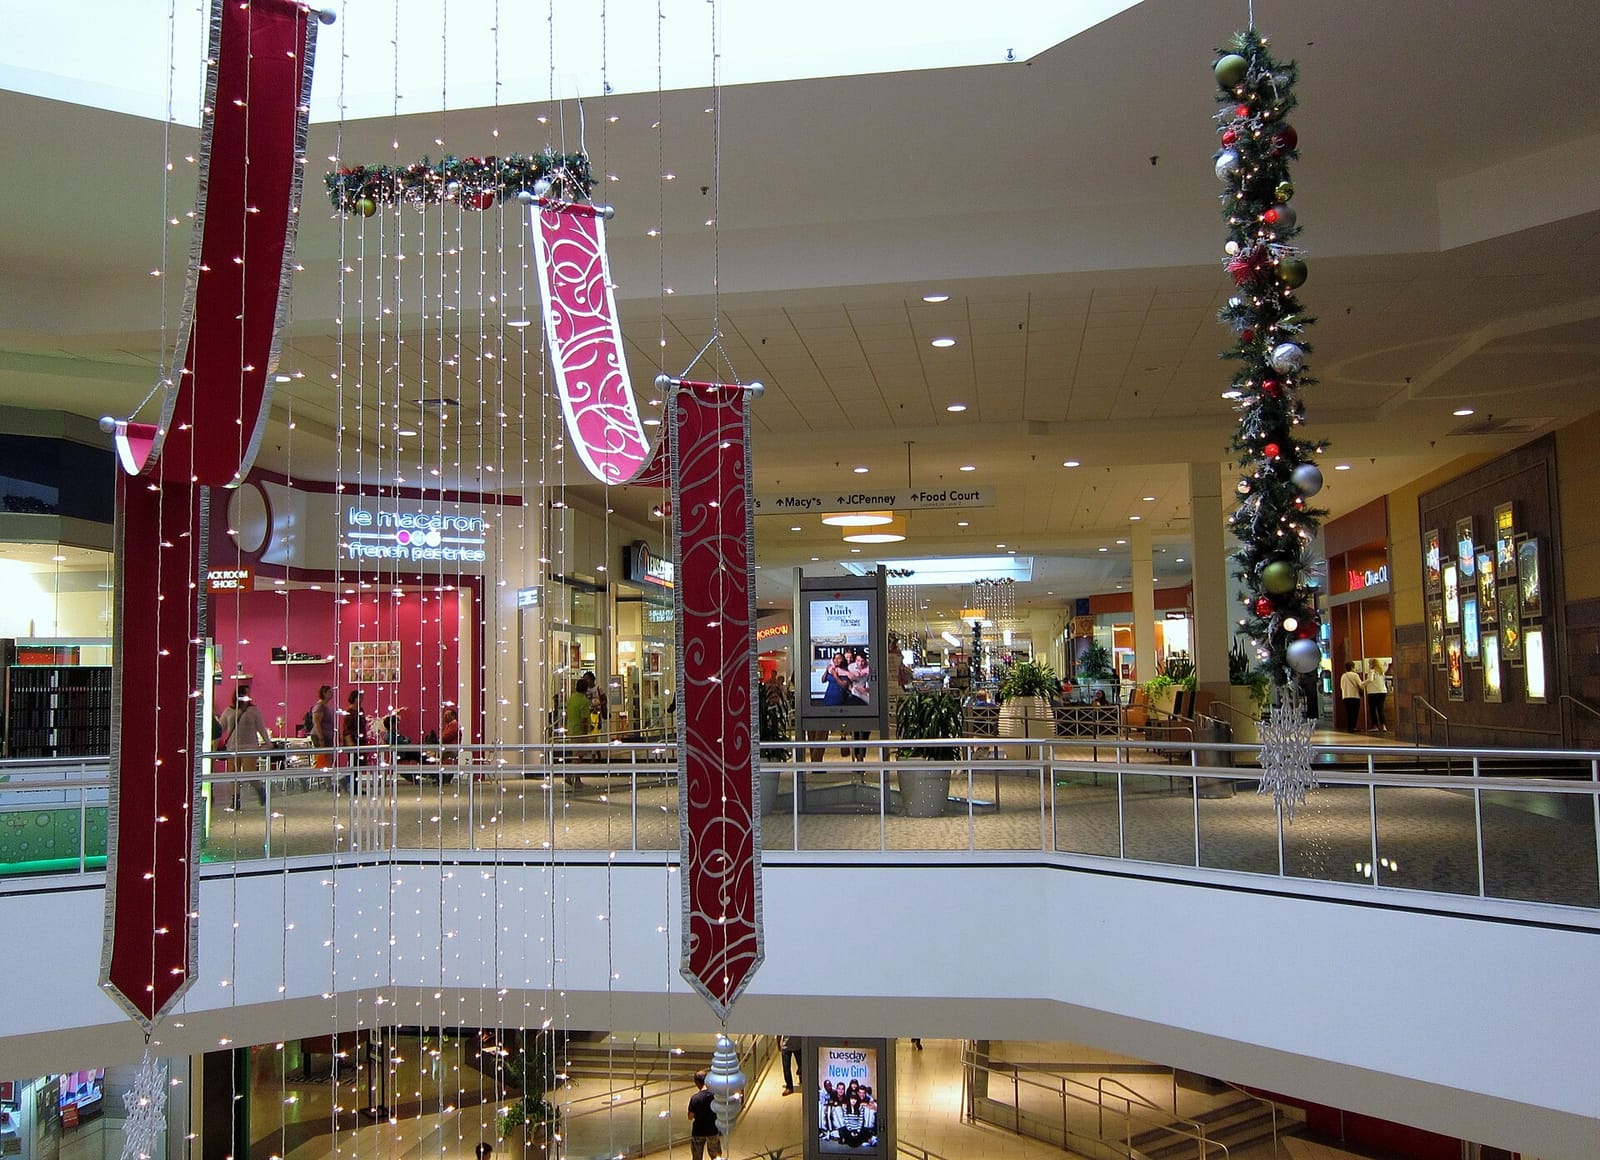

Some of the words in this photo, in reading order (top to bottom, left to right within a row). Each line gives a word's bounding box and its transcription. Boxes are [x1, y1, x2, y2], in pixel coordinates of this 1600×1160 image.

[845, 494, 896, 506] JCPenney
[919, 490, 947, 502] Food
[949, 490, 980, 501] Court
[785, 496, 822, 509] Macy's
[349, 506, 373, 526] le
[377, 511, 485, 532] macaron
[348, 541, 409, 559] french
[411, 546, 486, 561] pastries
[207, 571, 223, 580] ACK
[212, 579, 238, 589] SHOES
[829, 1050, 867, 1062] tuesday
[829, 1065, 850, 1078] New
[850, 1065, 867, 1078] Girl
